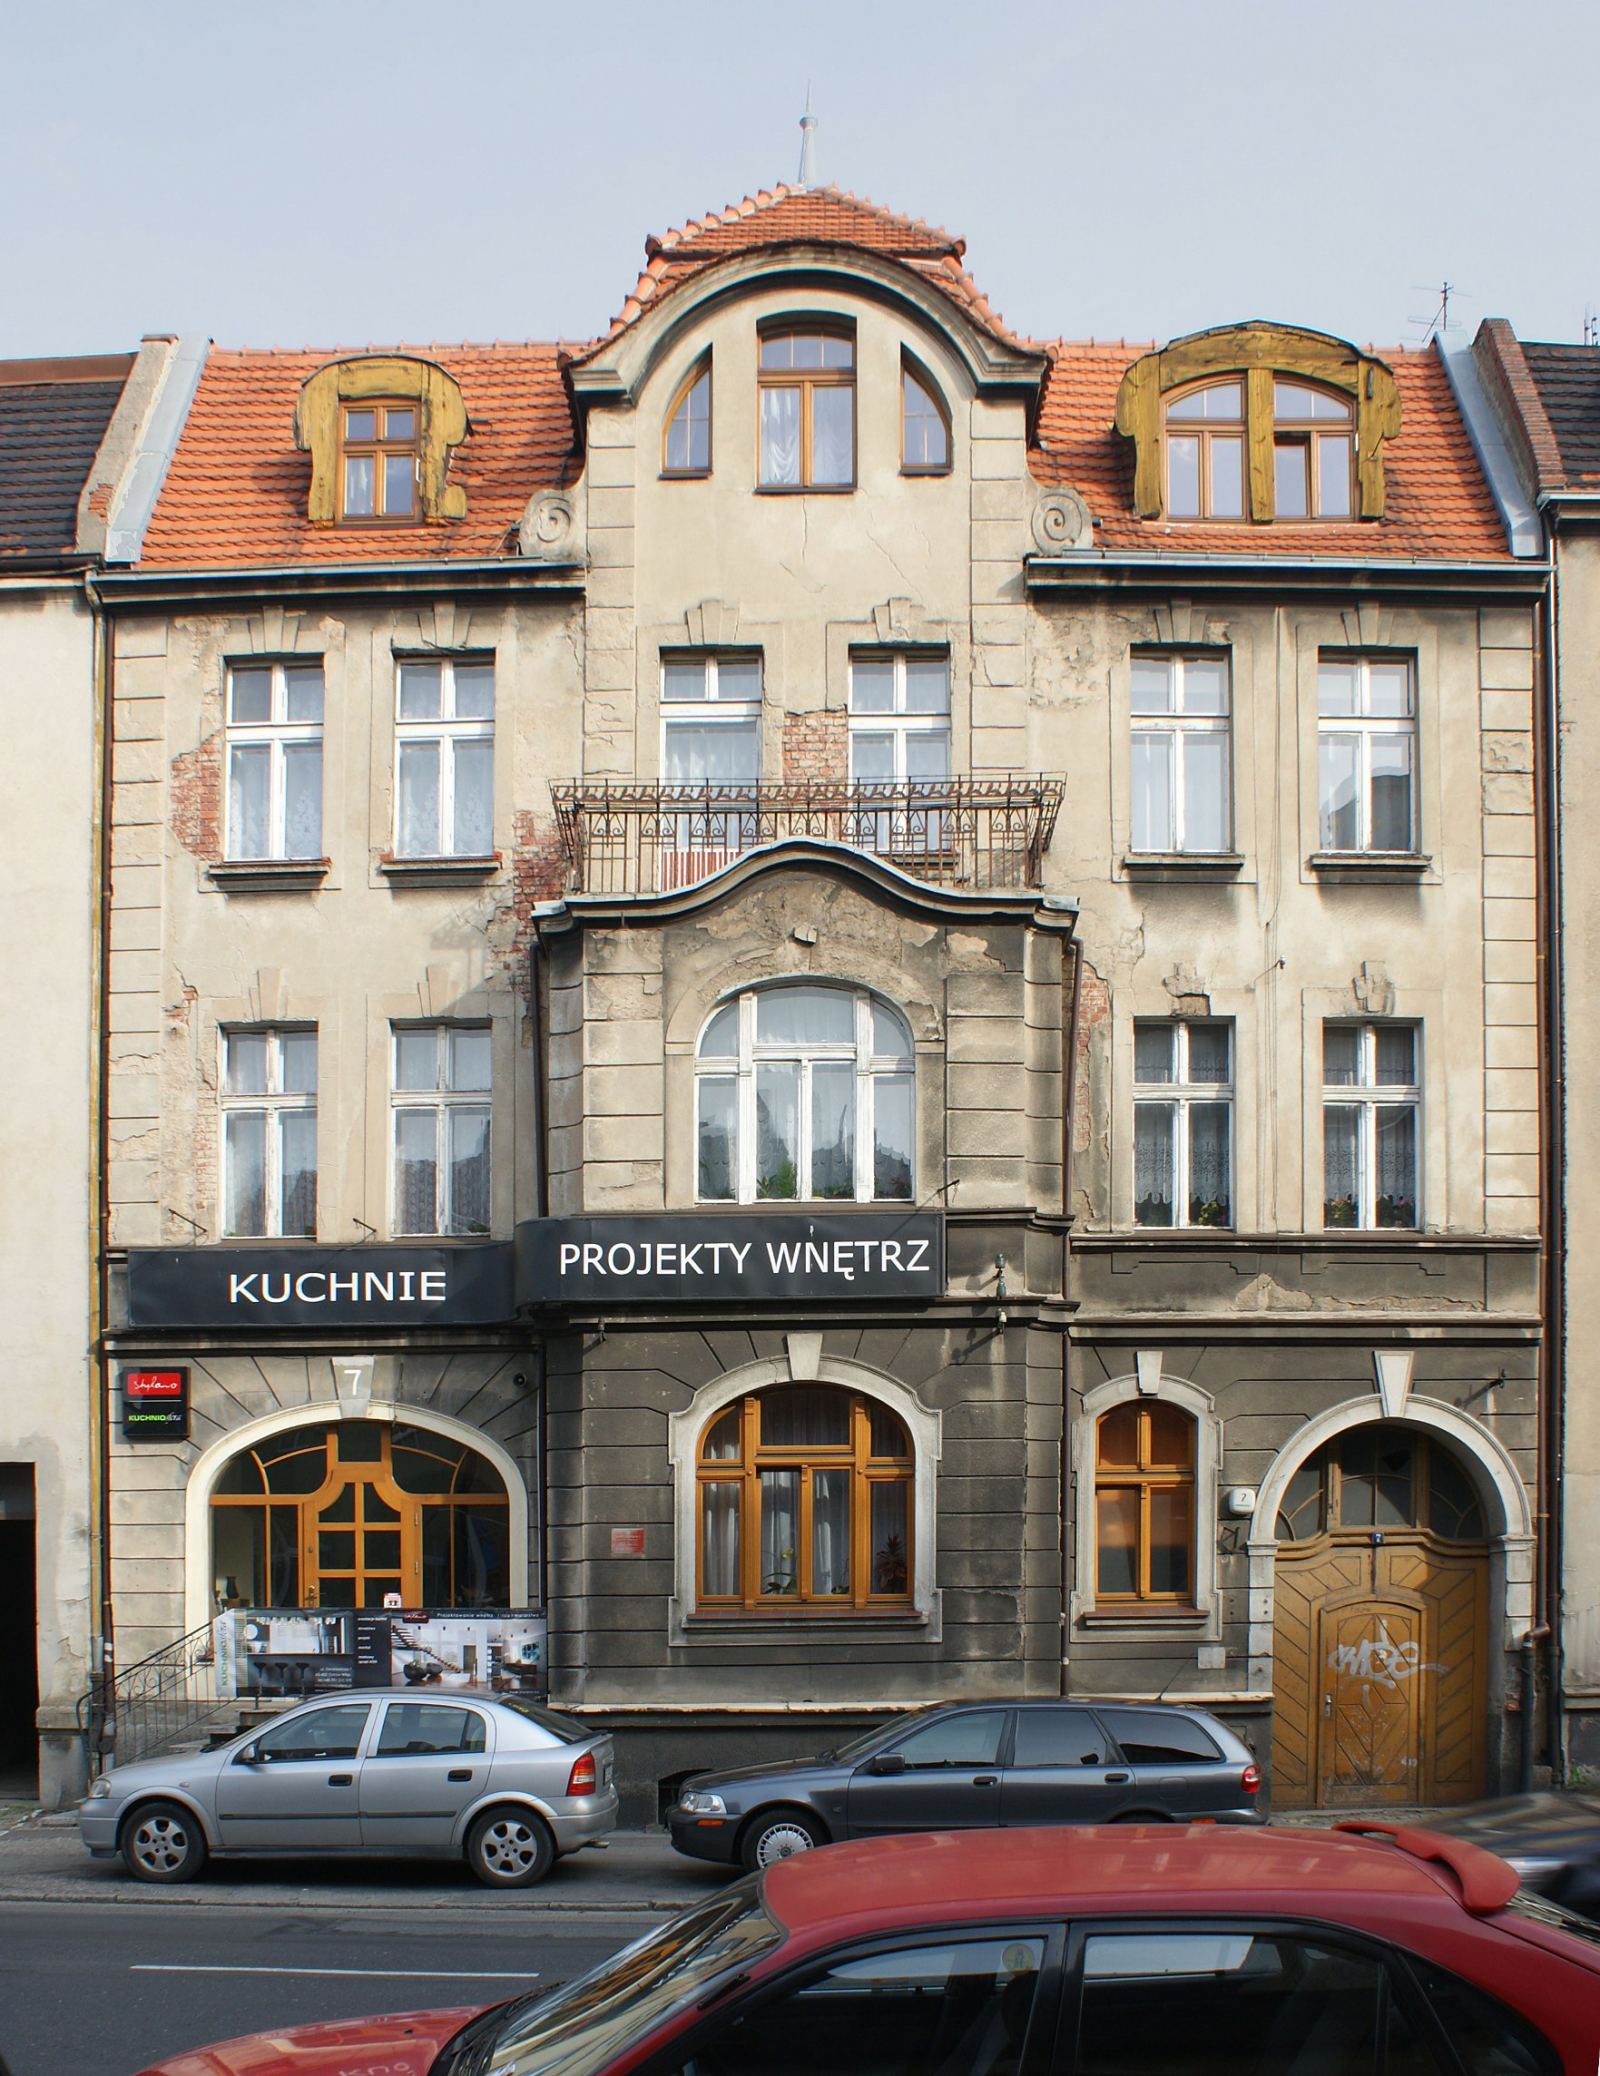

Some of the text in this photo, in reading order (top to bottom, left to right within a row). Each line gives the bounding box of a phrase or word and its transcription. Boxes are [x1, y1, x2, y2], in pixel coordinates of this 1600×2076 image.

[560, 1240, 930, 1280] PROJEKTY WNĘTRZ
[230, 1271, 447, 1303] KUCHNIE
[344, 1369, 362, 1396] 7
